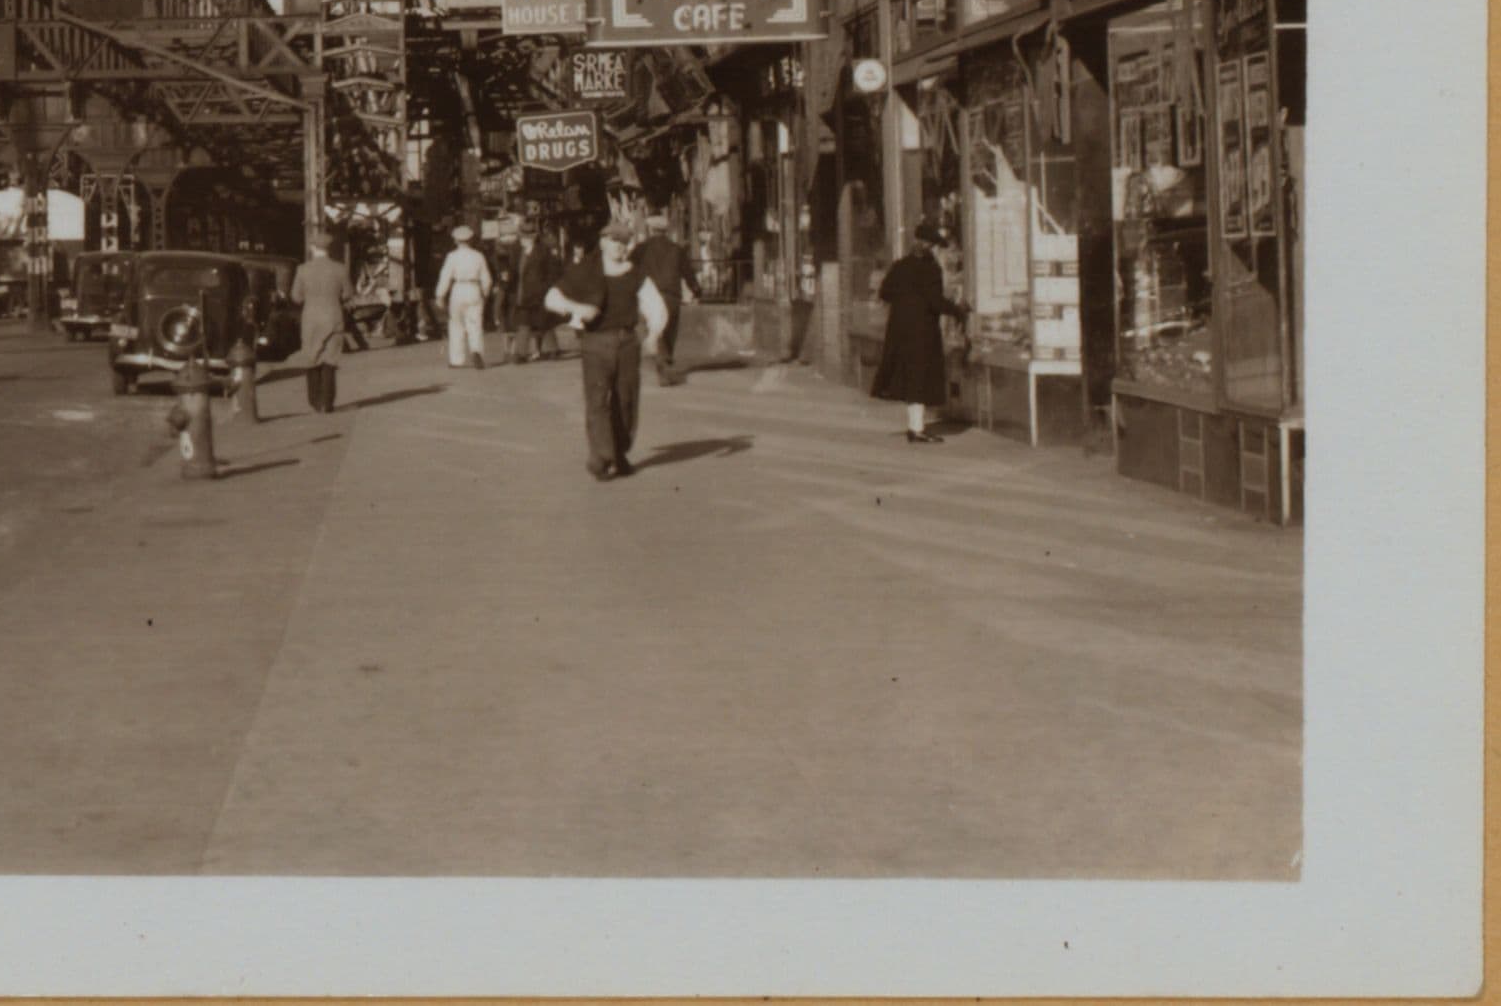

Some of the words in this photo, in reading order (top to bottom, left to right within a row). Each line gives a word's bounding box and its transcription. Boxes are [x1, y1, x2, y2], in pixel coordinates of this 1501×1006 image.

[507, 3, 570, 26] HOUSE
[673, 2, 746, 31] CAFE
[524, 140, 591, 161] DRUGS
